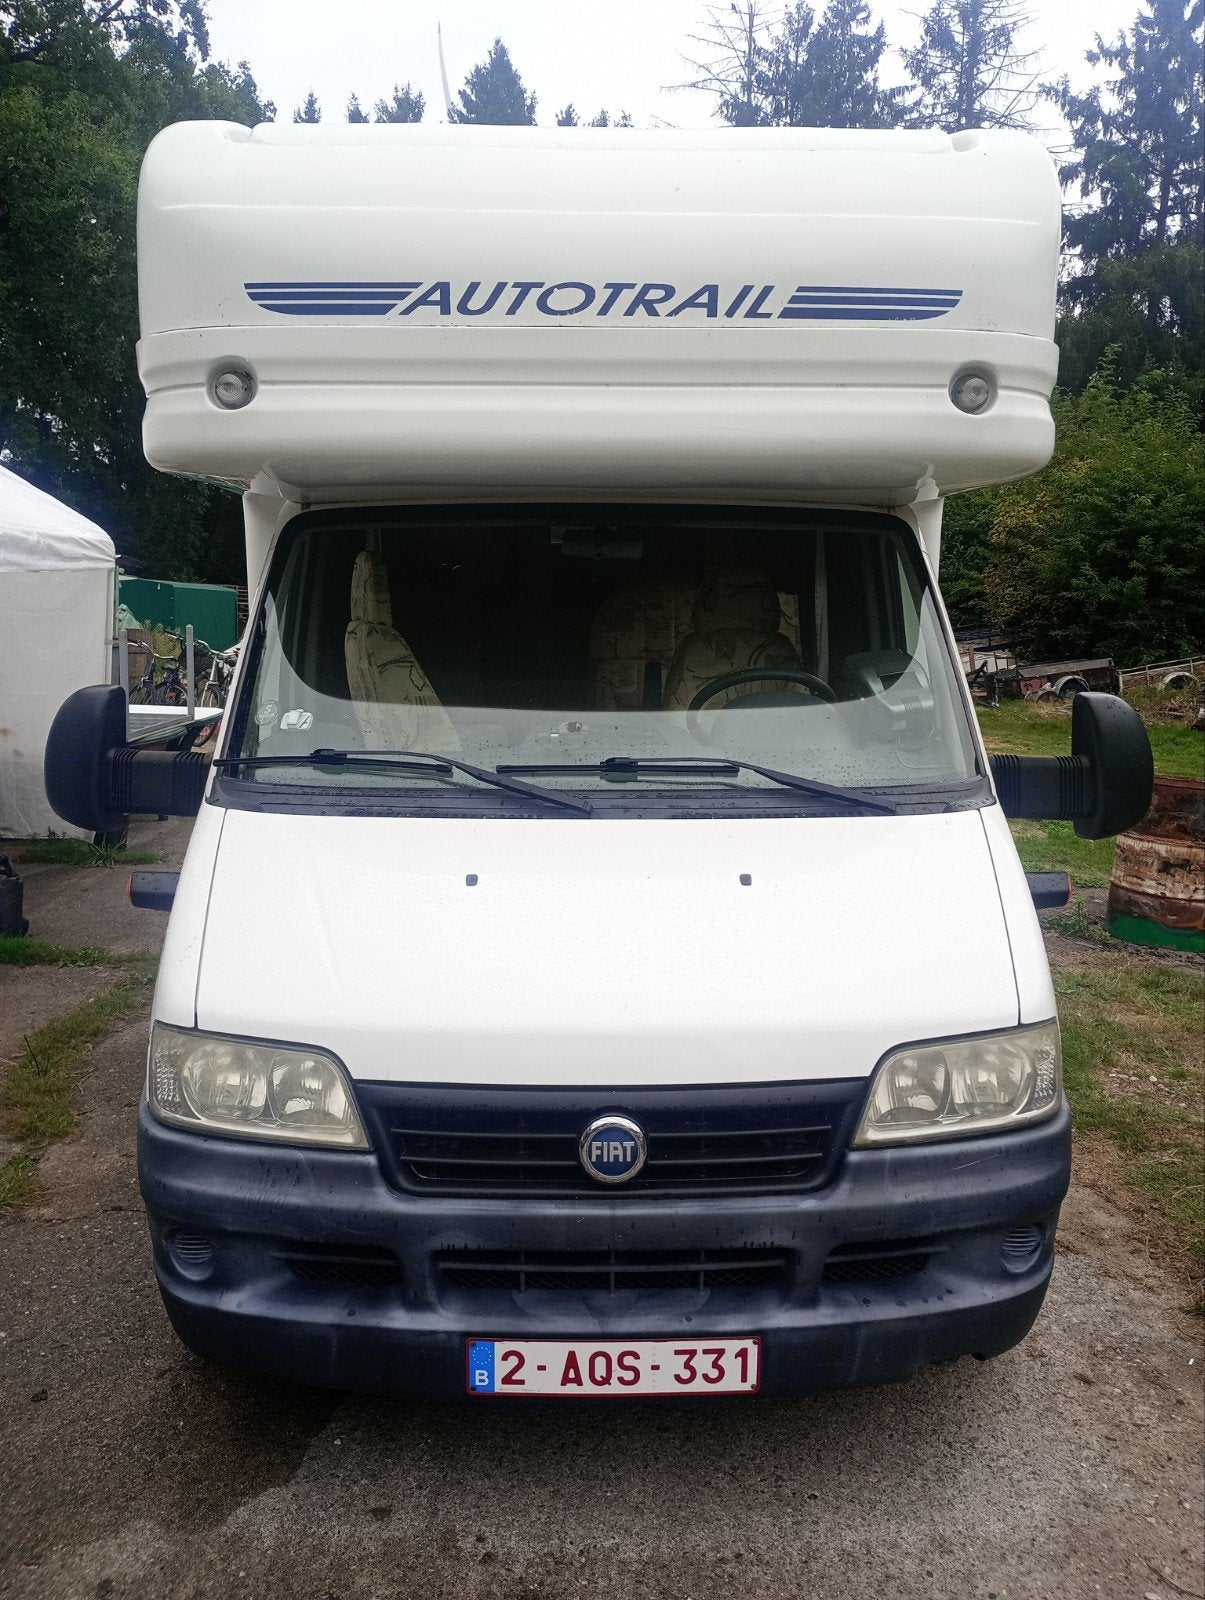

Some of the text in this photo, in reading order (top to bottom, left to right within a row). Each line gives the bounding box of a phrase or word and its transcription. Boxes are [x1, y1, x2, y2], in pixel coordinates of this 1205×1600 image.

[398, 281, 775, 319] AUTOTRAIL
[591, 1141, 635, 1163] FIAT
[475, 1370, 489, 1386] B
[501, 1347, 749, 1387] 2-AQS-331
